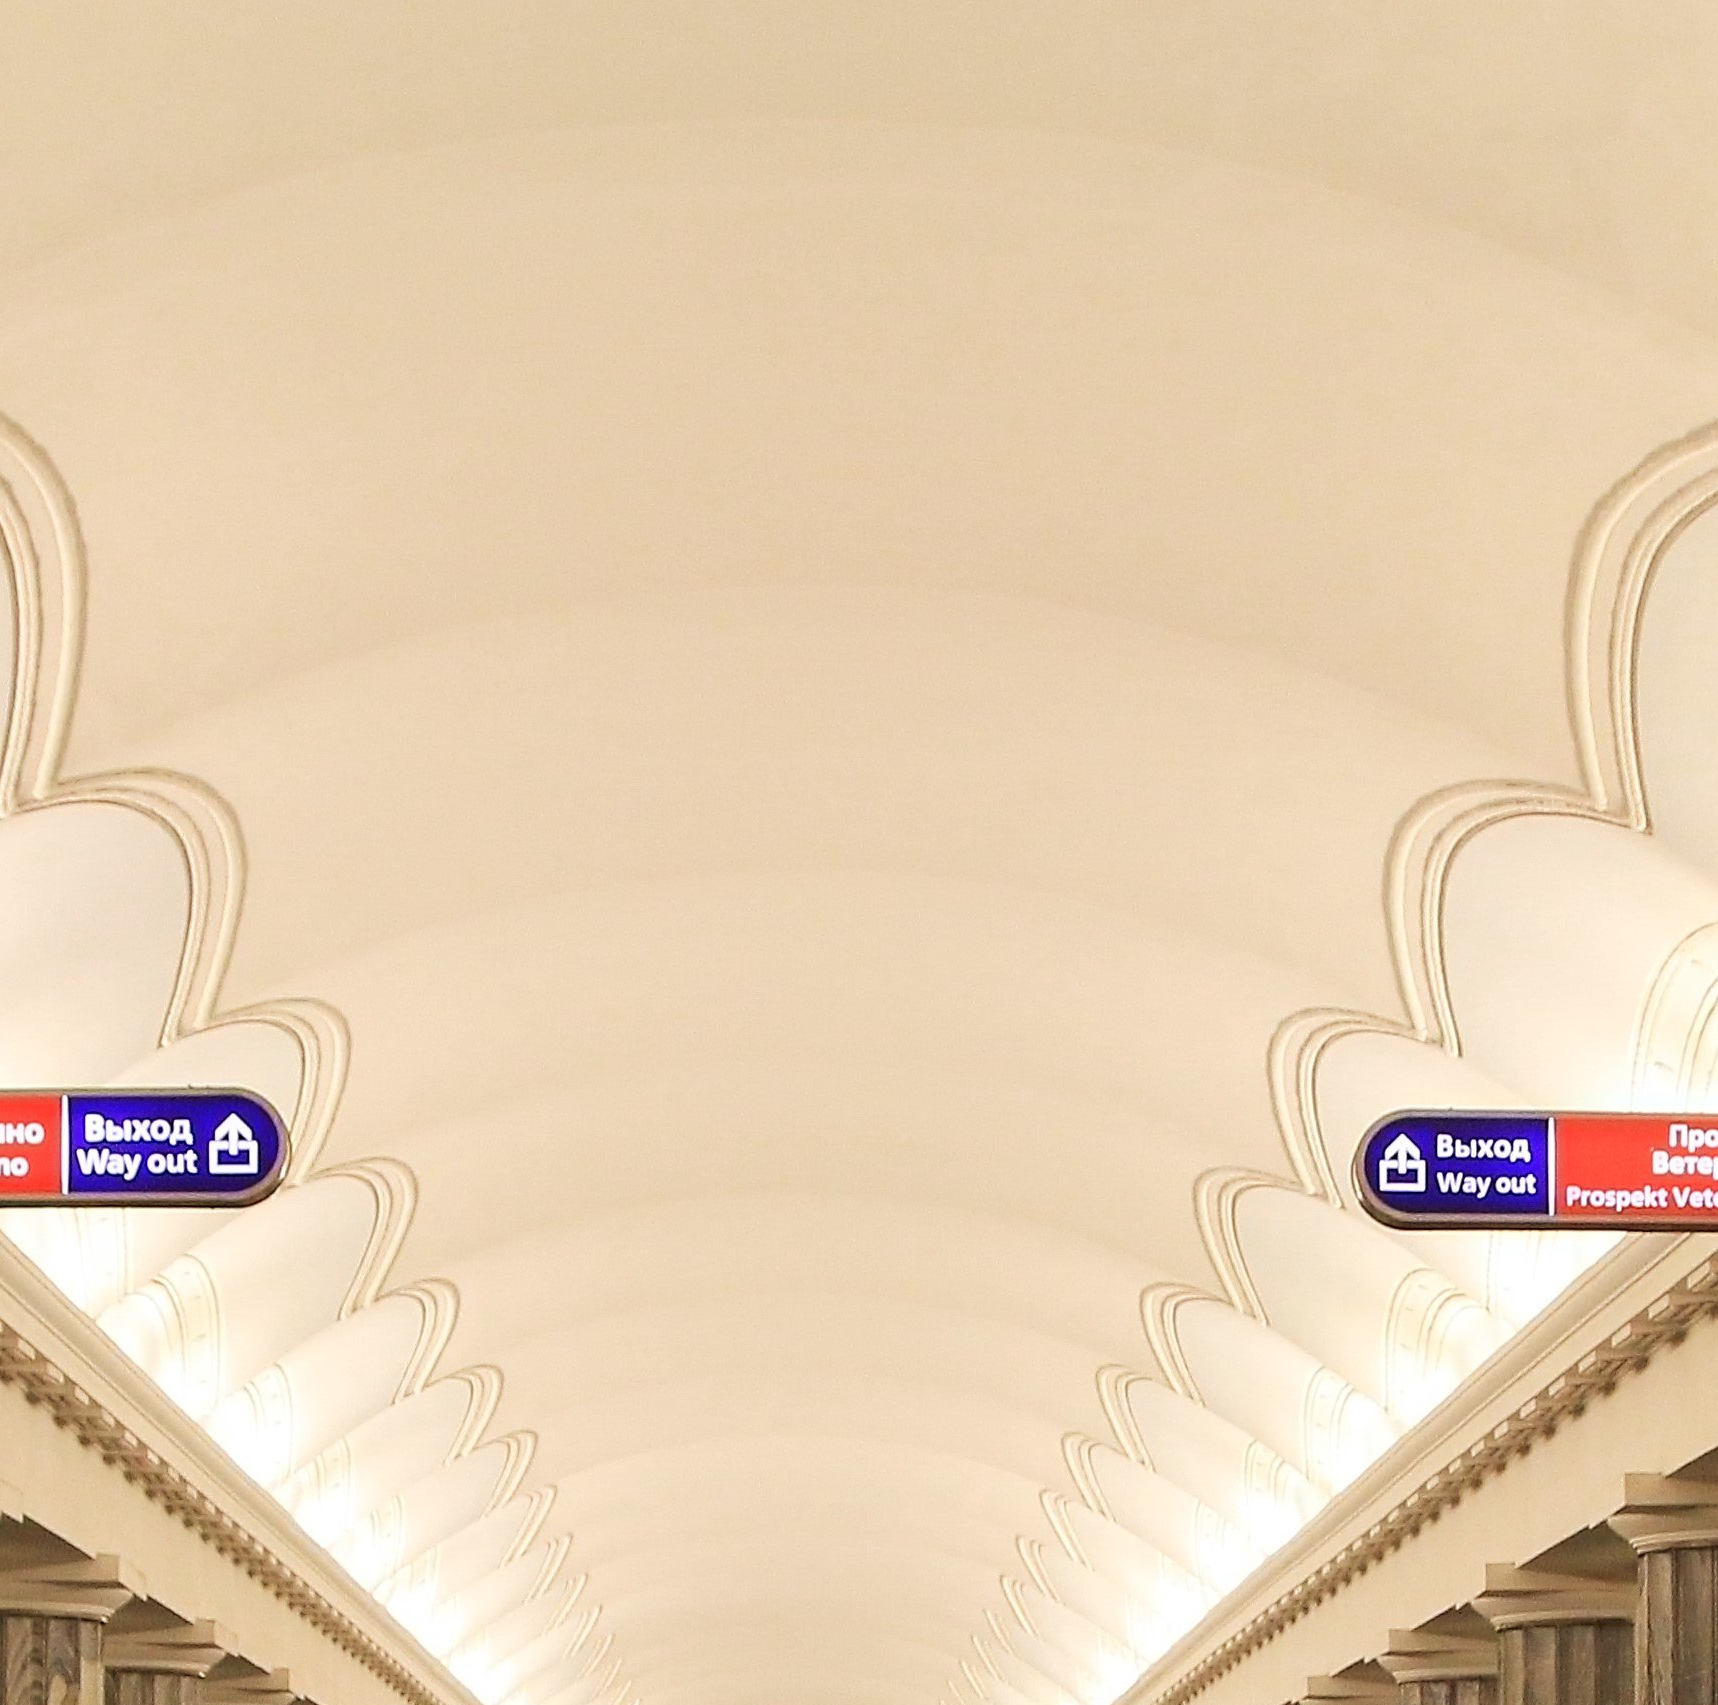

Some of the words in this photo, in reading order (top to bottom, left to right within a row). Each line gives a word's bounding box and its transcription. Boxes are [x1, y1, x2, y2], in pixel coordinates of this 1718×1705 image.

[84, 1113, 194, 1146] Выход
[1436, 1133, 1531, 1163] Выход
[76, 1148, 142, 1181] Way
[146, 1149, 198, 1174] out
[1436, 1172, 1492, 1199] Way
[1495, 1173, 1537, 1194] out
[1565, 1185, 1669, 1212] Prospekt
